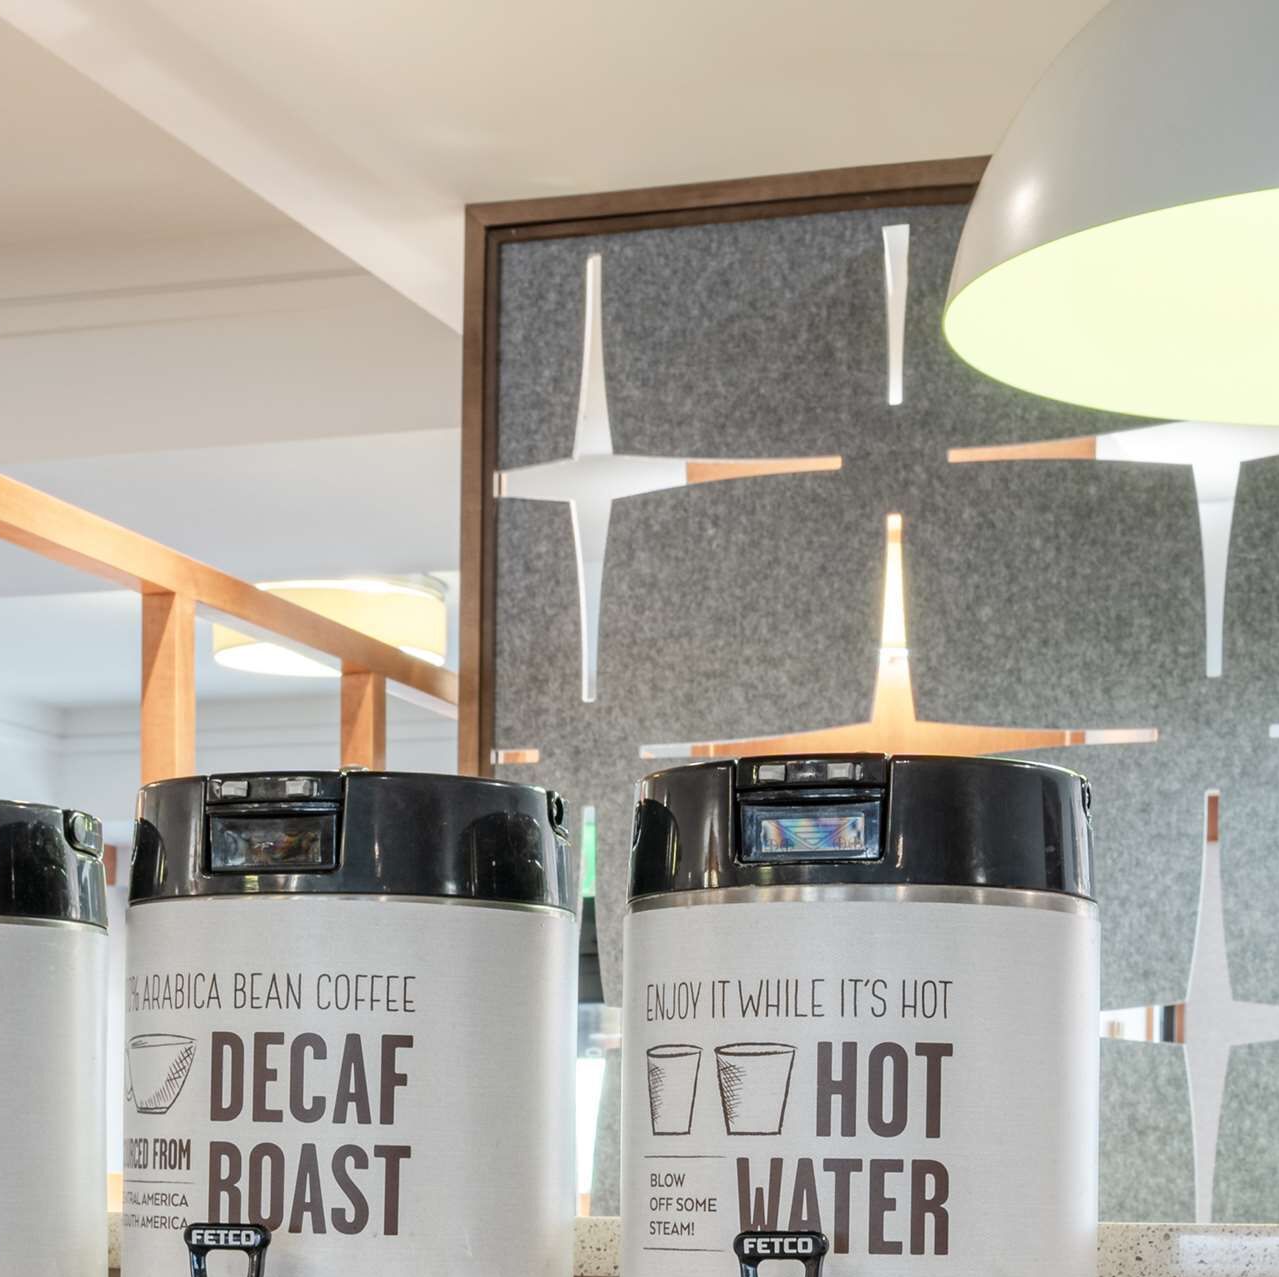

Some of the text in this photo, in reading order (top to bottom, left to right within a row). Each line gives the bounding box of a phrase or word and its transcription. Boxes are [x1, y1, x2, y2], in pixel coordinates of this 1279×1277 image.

[142, 972, 222, 1012] ARABICA
[233, 972, 302, 1010] BEAN
[316, 973, 417, 1013] COFFEE
[646, 978, 954, 1022] ENJOY IT WHILE IT'S HOT
[210, 1031, 414, 1126] DECAF
[816, 1041, 954, 1139] HOT
[152, 1138, 192, 1171] FROM
[208, 1141, 412, 1237] ROAST
[649, 1173, 686, 1188] BLOW
[141, 1192, 189, 1208] AMERICA
[649, 1197, 718, 1212] OFF SOME
[736, 1157, 950, 1256] WATER
[140, 1215, 189, 1231] AMERICA
[649, 1220, 695, 1236] STEAM!
[191, 1229, 256, 1246] FETCO
[743, 1237, 814, 1254] FETCO
